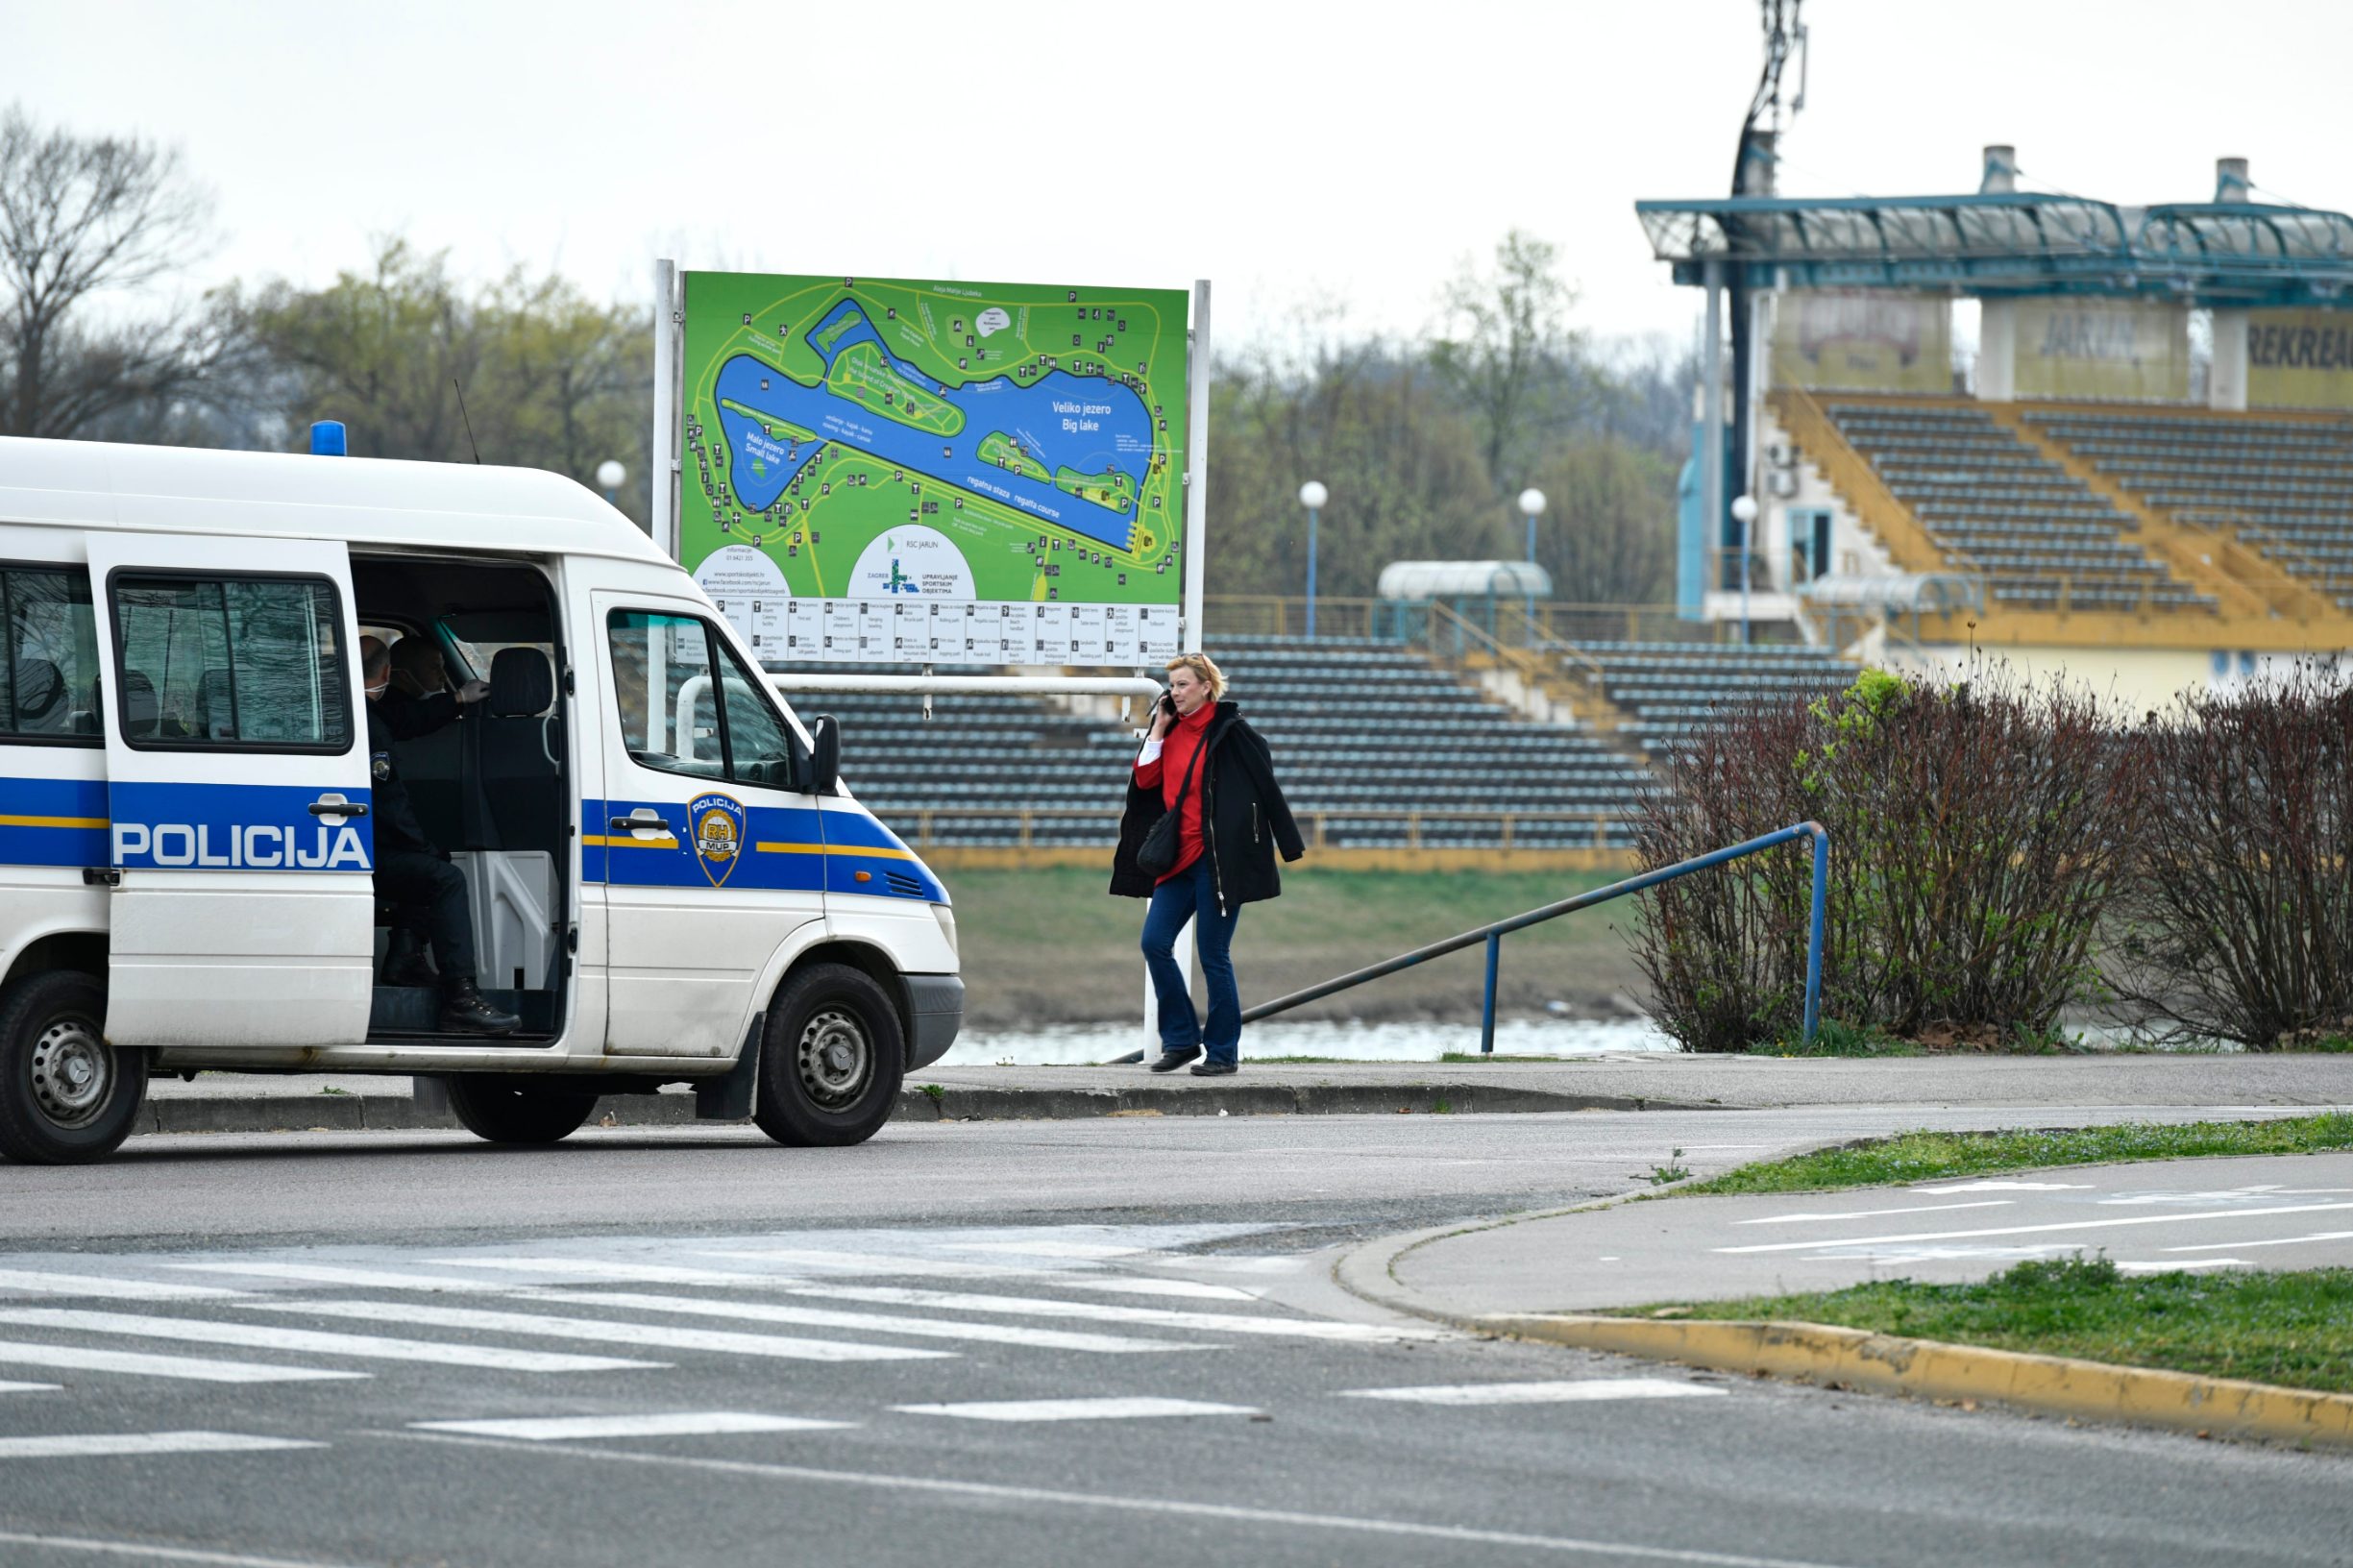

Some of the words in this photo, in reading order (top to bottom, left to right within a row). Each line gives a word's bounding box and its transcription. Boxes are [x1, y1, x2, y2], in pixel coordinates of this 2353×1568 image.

[2248, 324, 2353, 371] REKREA
[1053, 402, 1081, 413] Veliko
[1082, 403, 1111, 416] jezero
[1062, 419, 1077, 433] Big
[1079, 420, 1099, 431] lake
[745, 443, 765, 458] Small
[766, 452, 780, 465] lake
[746, 432, 763, 445] Malo
[763, 440, 784, 455] jezero
[967, 476, 992, 491] regatna
[993, 486, 1010, 499] staza
[1014, 495, 1037, 509] regatta
[1037, 503, 1060, 518] course
[919, 541, 938, 550] JARUN
[692, 798, 742, 816] POLICIJA
[708, 824, 728, 840] RH
[112, 823, 372, 868] POLICIJA
